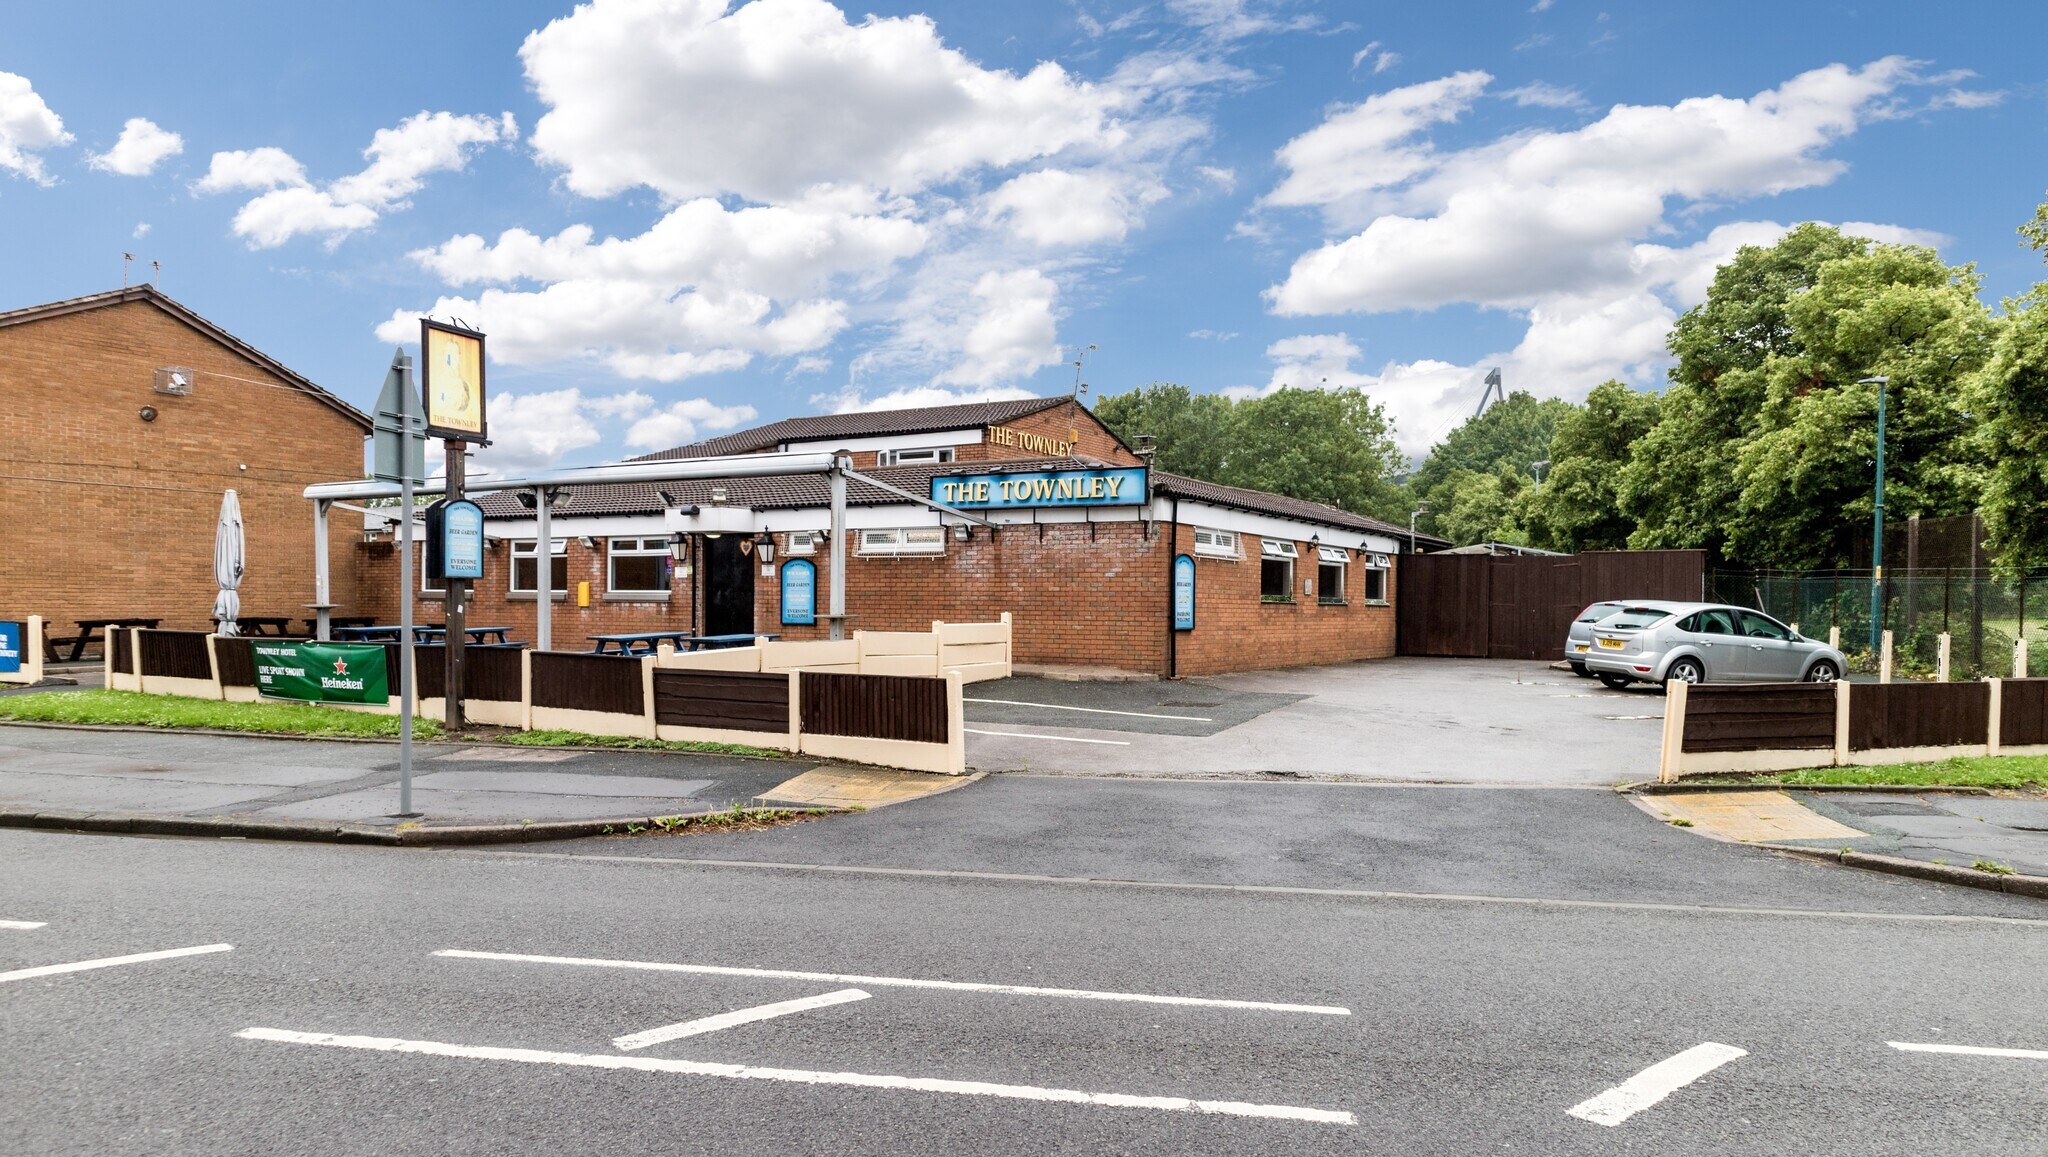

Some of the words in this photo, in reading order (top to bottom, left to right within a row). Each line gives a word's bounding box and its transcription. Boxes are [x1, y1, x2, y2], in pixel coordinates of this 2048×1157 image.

[433, 415, 445, 423] THE
[447, 417, 477, 428] TOWNLEY
[988, 425, 1013, 446] THE
[1017, 432, 1073, 457] TOWNLEY
[943, 482, 990, 503] THE
[1001, 476, 1125, 501] TOWNLEY
[256, 647, 279, 656] TOWNLEY
[280, 648, 297, 656] HOTEL
[258, 666, 269, 674] LIVE
[269, 667, 285, 676] SPORT
[285, 668, 305, 677] SHOWN
[260, 675, 273, 684] HERE
[321, 677, 363, 690] Heineken
